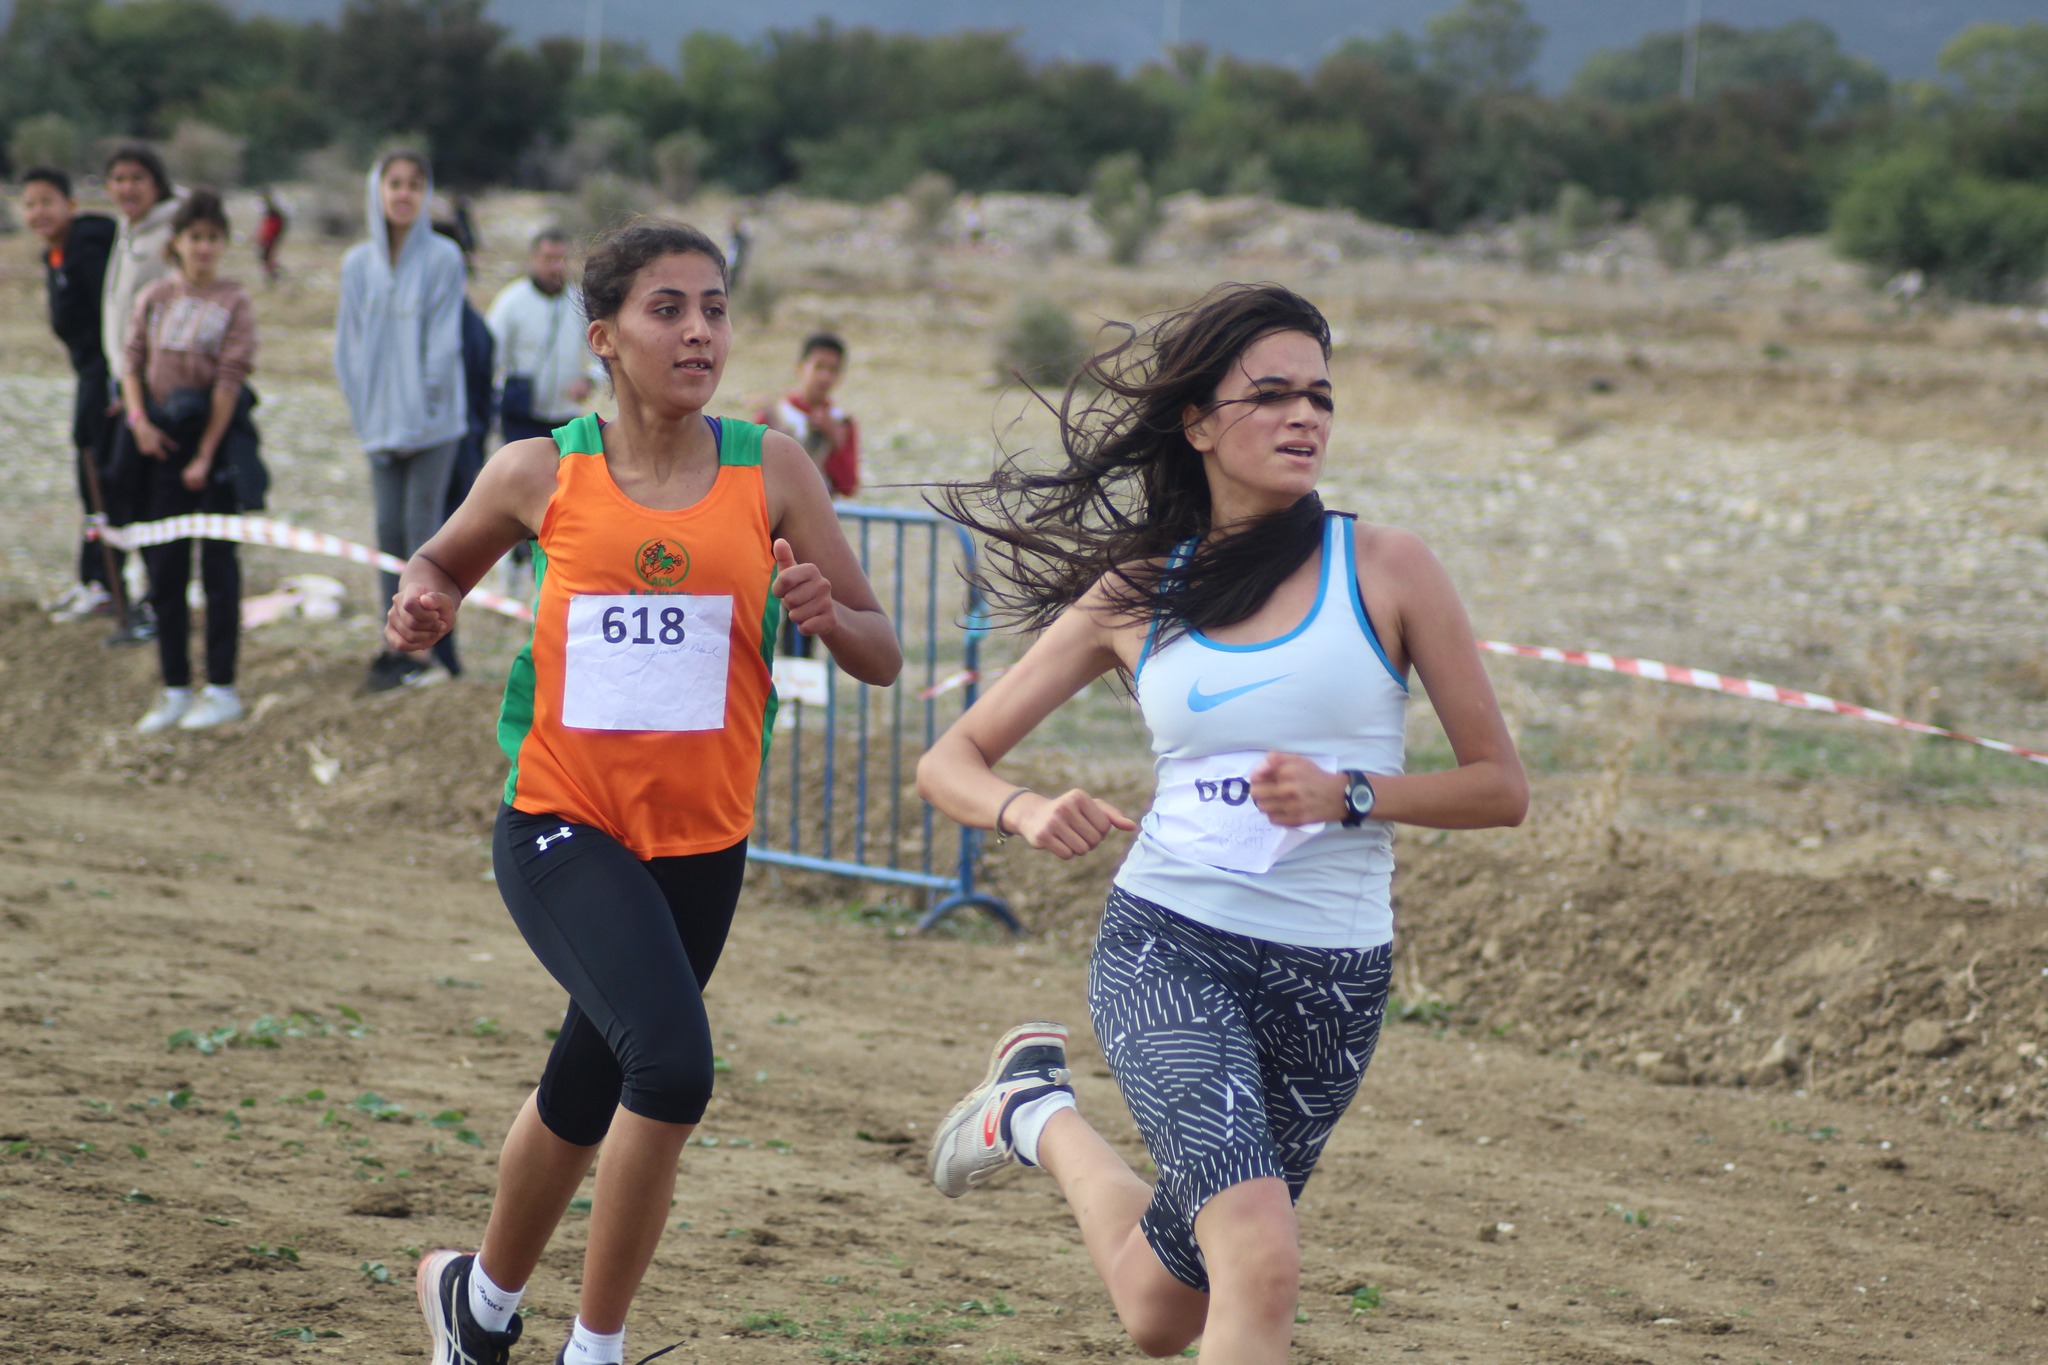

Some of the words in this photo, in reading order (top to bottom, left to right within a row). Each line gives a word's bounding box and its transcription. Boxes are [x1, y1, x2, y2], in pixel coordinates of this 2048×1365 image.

[651, 576, 673, 587] ACN
[602, 606, 685, 645] 618
[481, 1292, 505, 1312] asics
